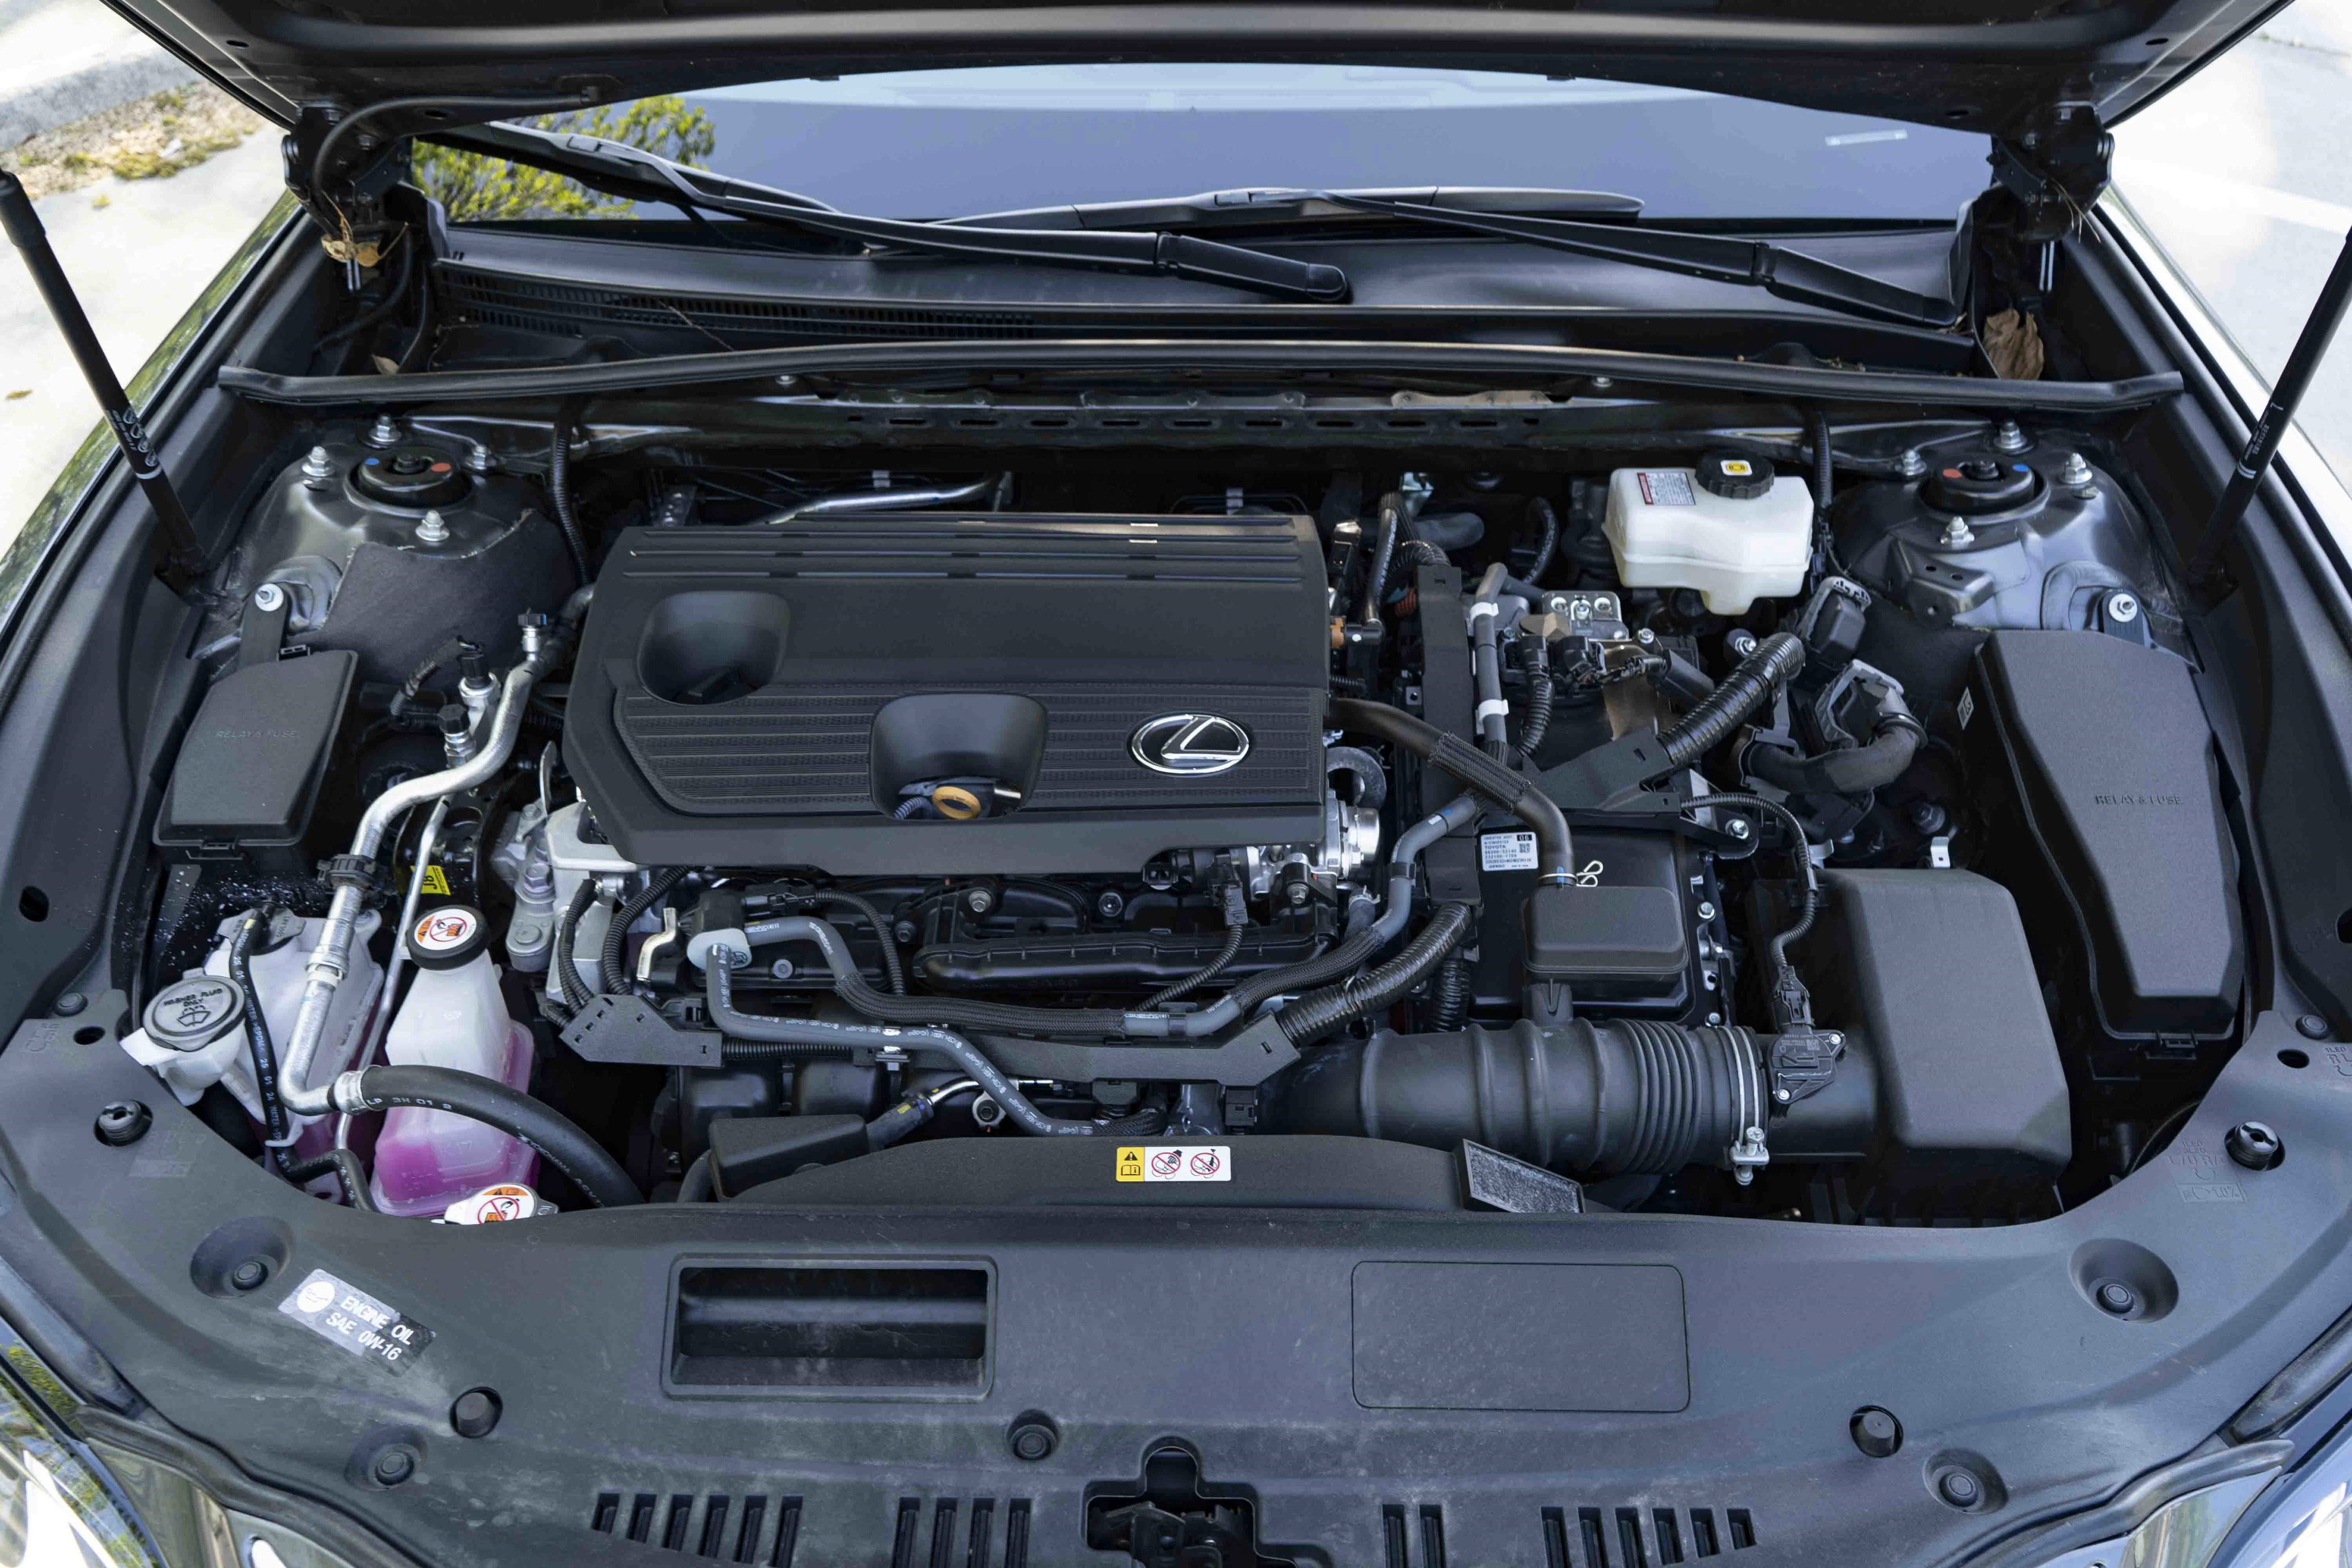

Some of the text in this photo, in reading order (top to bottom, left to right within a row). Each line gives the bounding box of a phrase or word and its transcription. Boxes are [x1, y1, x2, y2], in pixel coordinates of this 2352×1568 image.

[2095, 795, 2135, 805] RELAY
[2150, 795, 2182, 805] FUSE
[184, 998, 203, 1007] ONLY
[260, 1058, 269, 1069] 25
[263, 1076, 273, 1085] 01
[265, 1091, 275, 1101] 24
[340, 1296, 416, 1345] ENGINE OIL
[326, 1312, 402, 1361] SAE 0W-16
